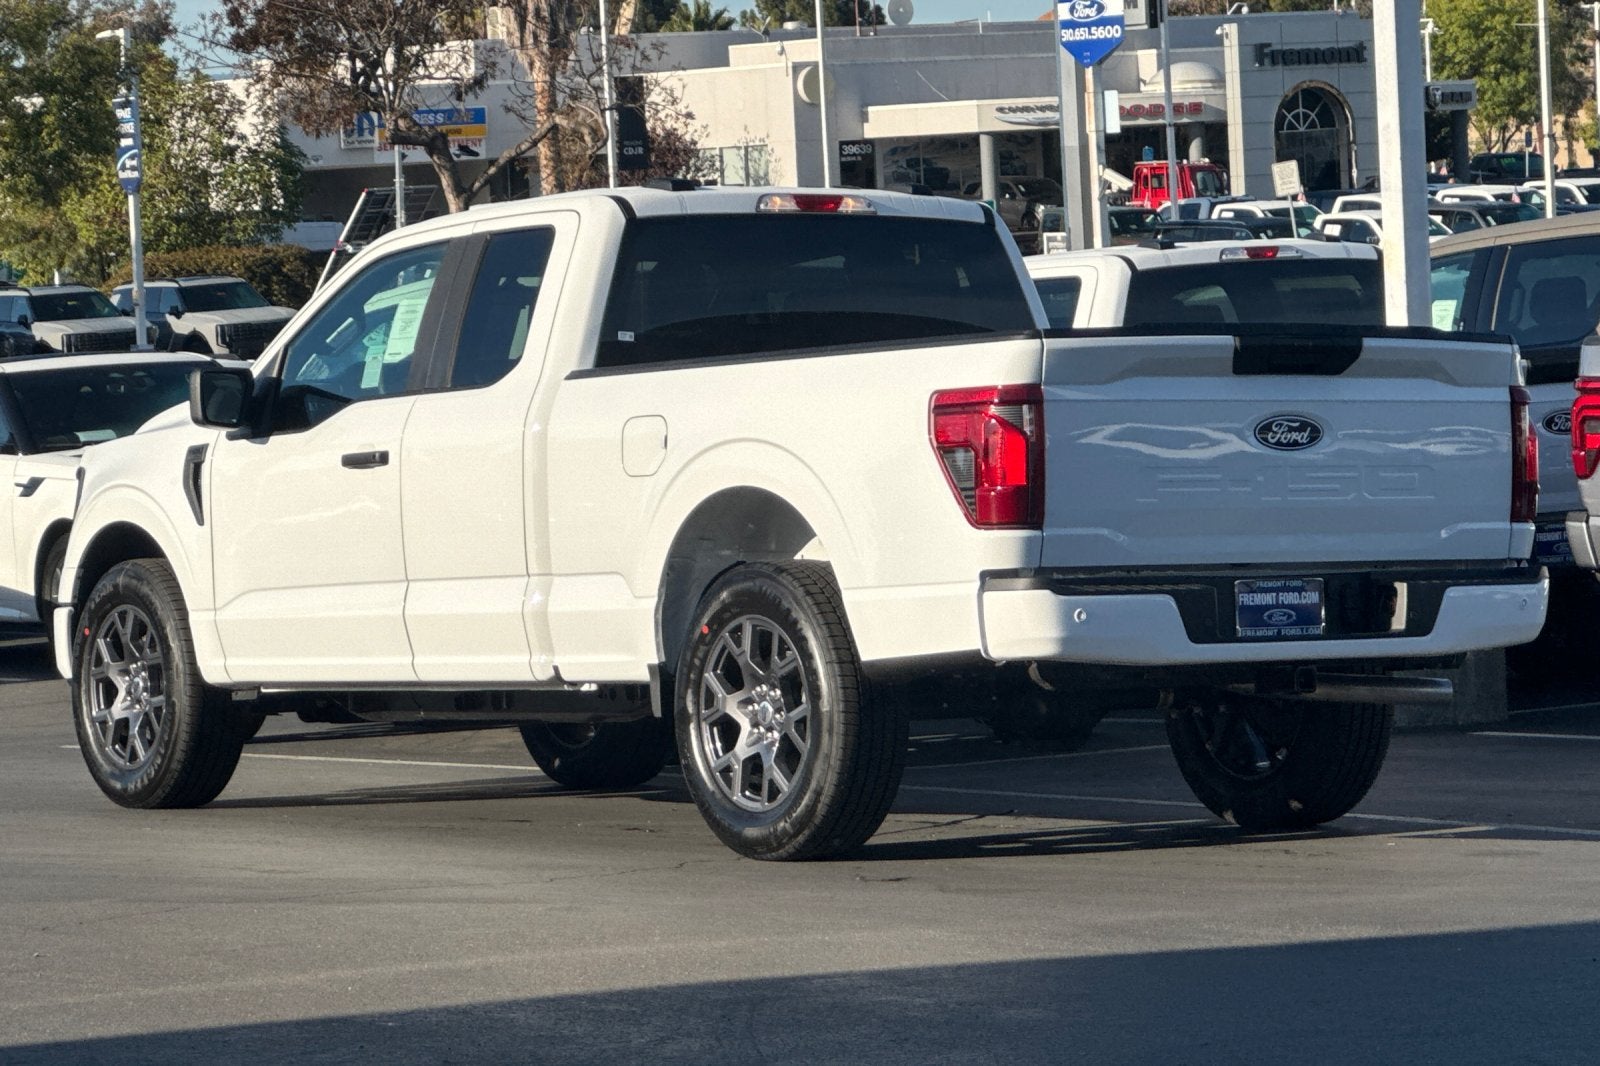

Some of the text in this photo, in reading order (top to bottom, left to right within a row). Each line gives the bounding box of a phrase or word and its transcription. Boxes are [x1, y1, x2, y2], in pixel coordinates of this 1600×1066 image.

[1072, 0, 1098, 17] Ford
[1061, 25, 1122, 42] 510.651.5600
[1253, 41, 1367, 67] Fremont
[377, 142, 417, 152] SERICE
[623, 146, 644, 155] CDJR
[841, 144, 872, 155] 39639
[1551, 413, 1572, 431] For
[1267, 420, 1311, 445] Ford
[1256, 580, 1285, 588] FREMONT
[1238, 591, 1320, 606] FREMONT FORD.COM
[1241, 627, 1321, 637] FREMONT FORD.COM
